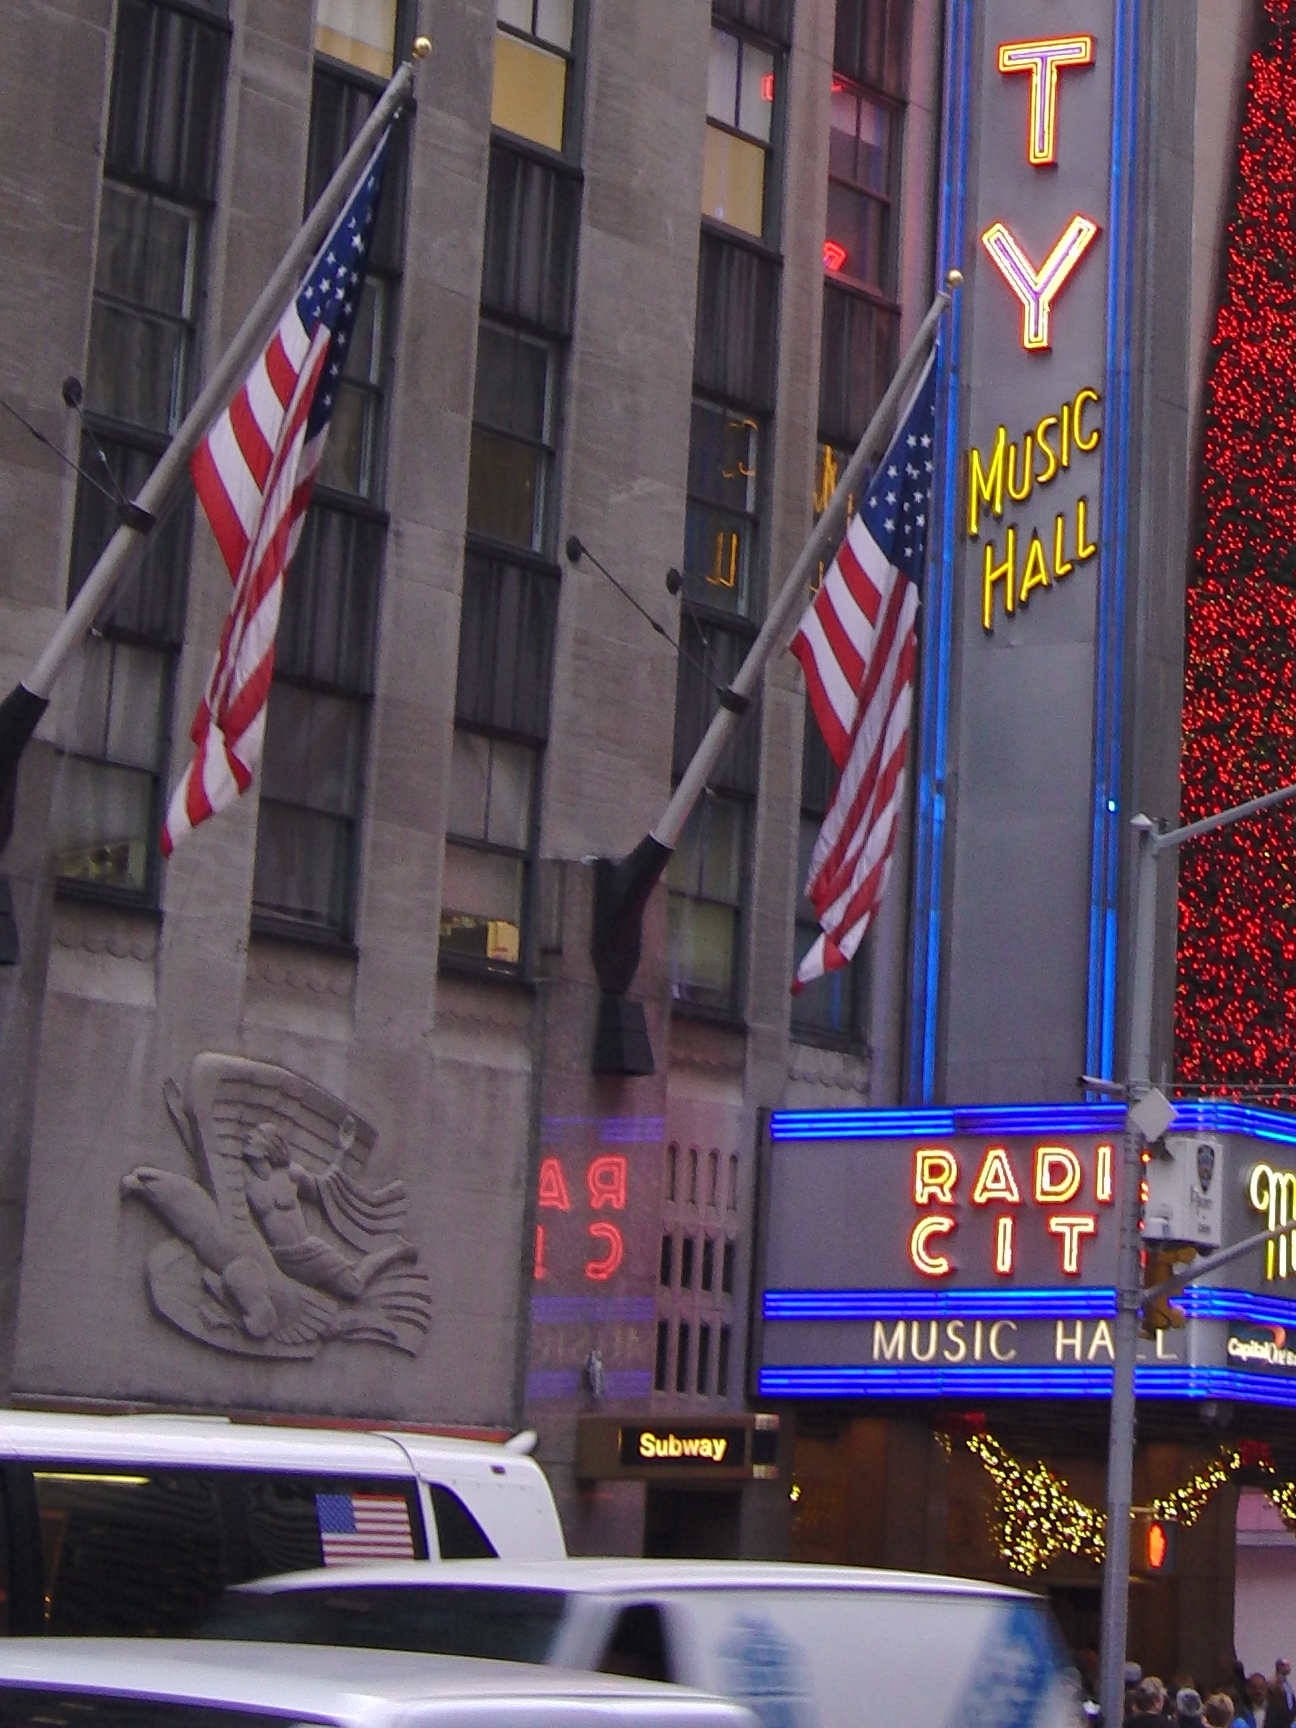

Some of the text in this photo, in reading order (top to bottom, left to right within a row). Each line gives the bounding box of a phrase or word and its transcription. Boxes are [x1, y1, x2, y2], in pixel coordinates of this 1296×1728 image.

[967, 386, 1100, 536] MUSIC
[981, 498, 1097, 631] HALL
[914, 1144, 1150, 1205] RADI
[909, 1214, 1149, 1275] CIT
[872, 1320, 1178, 1362] MUSIC HAL
[638, 1431, 728, 1462] Subway
